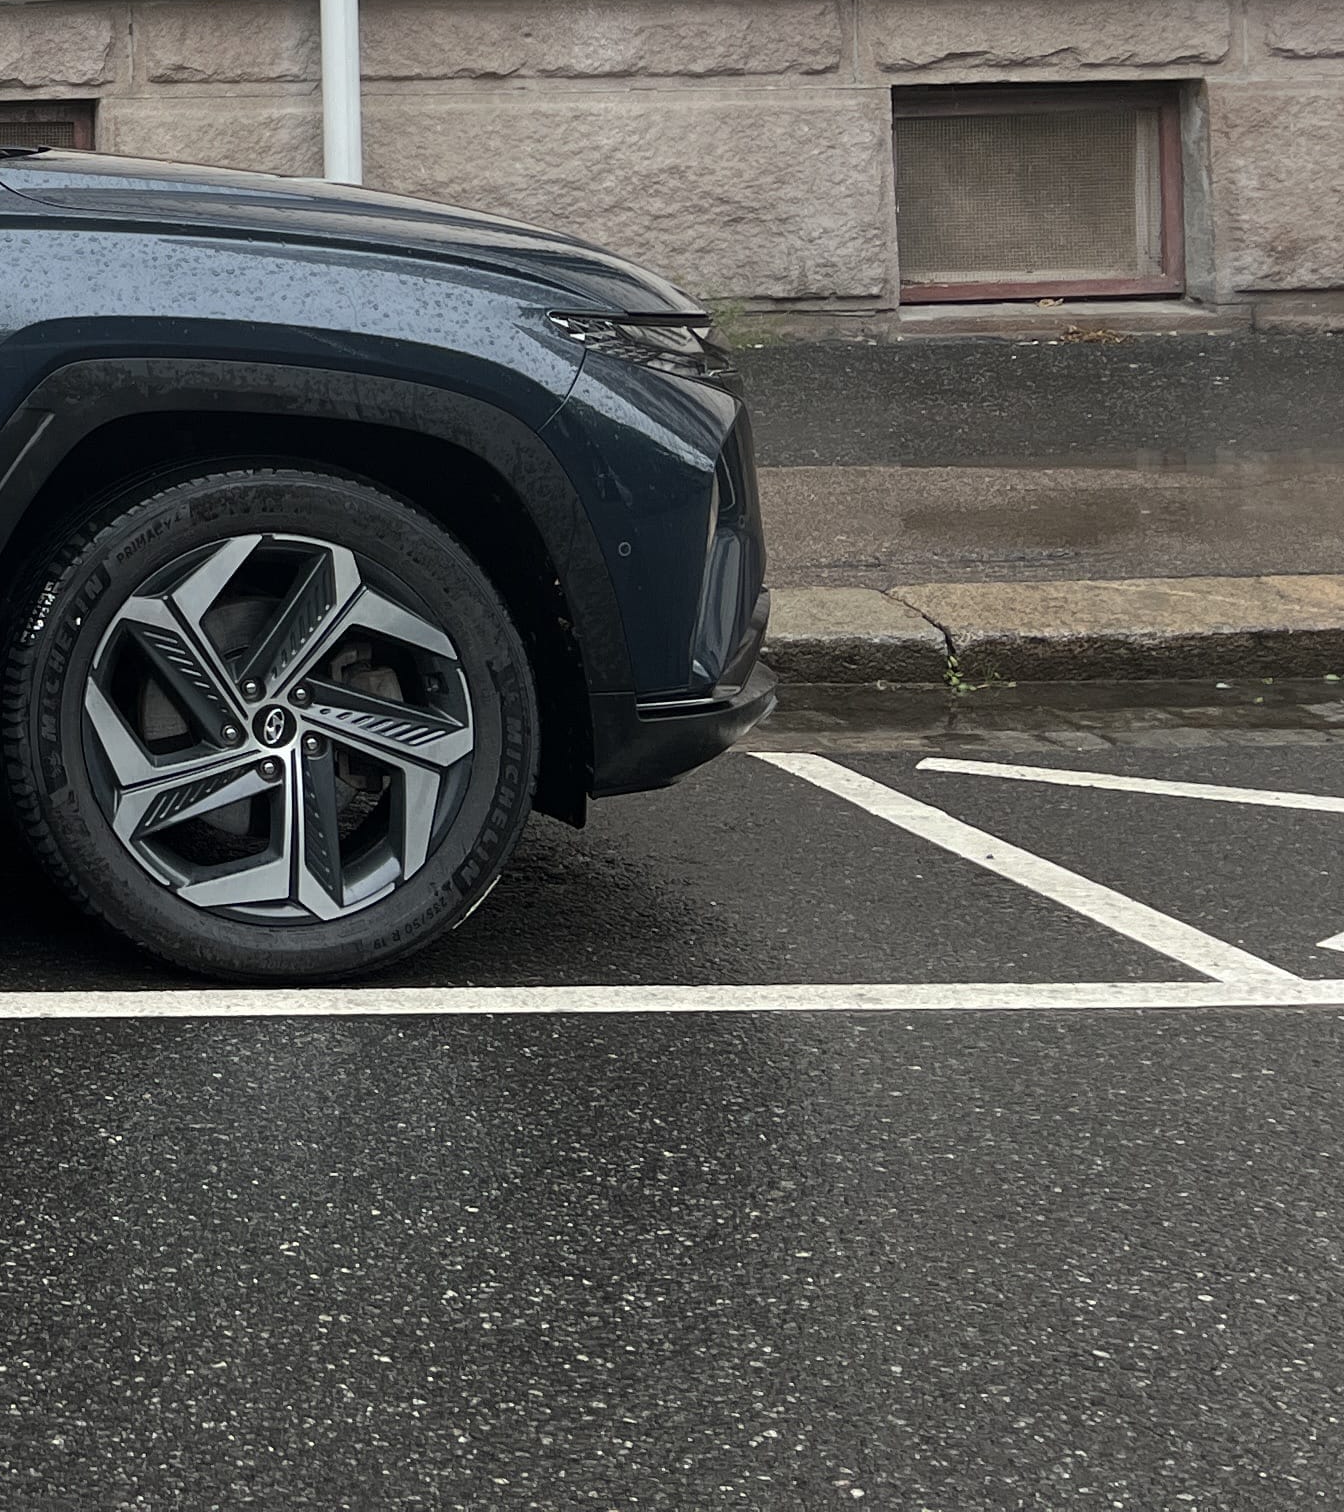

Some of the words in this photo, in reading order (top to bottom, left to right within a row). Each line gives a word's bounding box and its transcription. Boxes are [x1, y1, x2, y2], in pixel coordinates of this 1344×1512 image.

[116, 517, 173, 565] PRIMACY
[40, 573, 104, 742] MICHELIN
[460, 715, 523, 888] MICHELIN
